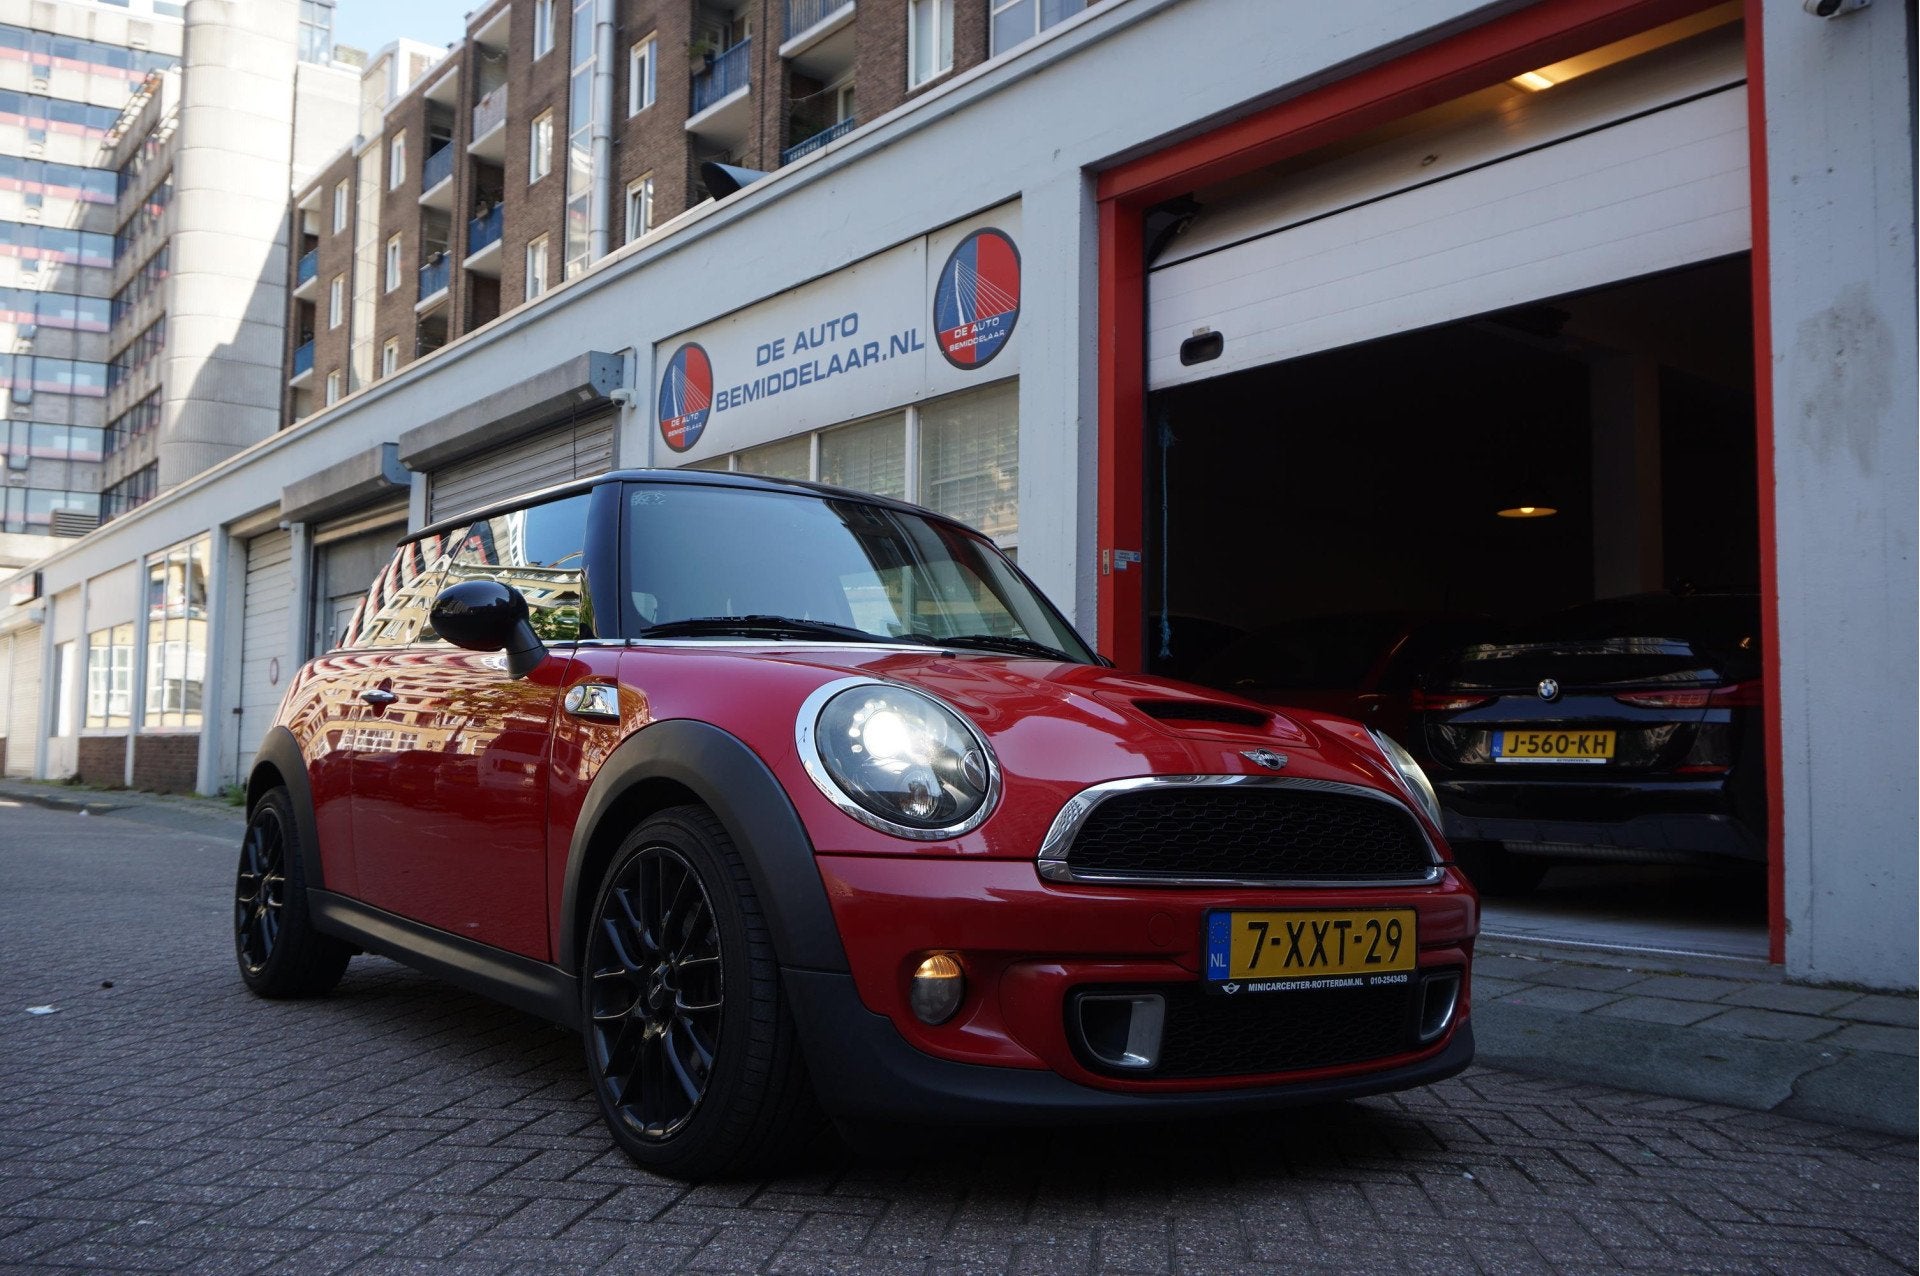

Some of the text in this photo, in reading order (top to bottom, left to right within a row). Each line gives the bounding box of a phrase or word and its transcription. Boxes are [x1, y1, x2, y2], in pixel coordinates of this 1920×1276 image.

[954, 317, 1000, 338] DE AUTO
[756, 312, 859, 367] DE AUTO
[949, 329, 1005, 352] BEMIDDELAAR
[716, 328, 925, 413] BEMIDDELAAR.NL
[671, 412, 699, 427] DE AUTO
[1508, 734, 1608, 754] J-560-KH
[1248, 918, 1403, 970] 7-XXT-29
[1210, 953, 1227, 968] NL
[1248, 979, 1364, 992] MINICARCENTER-ROTTERDAM.NL
[1370, 974, 1408, 985] 010-2543439
